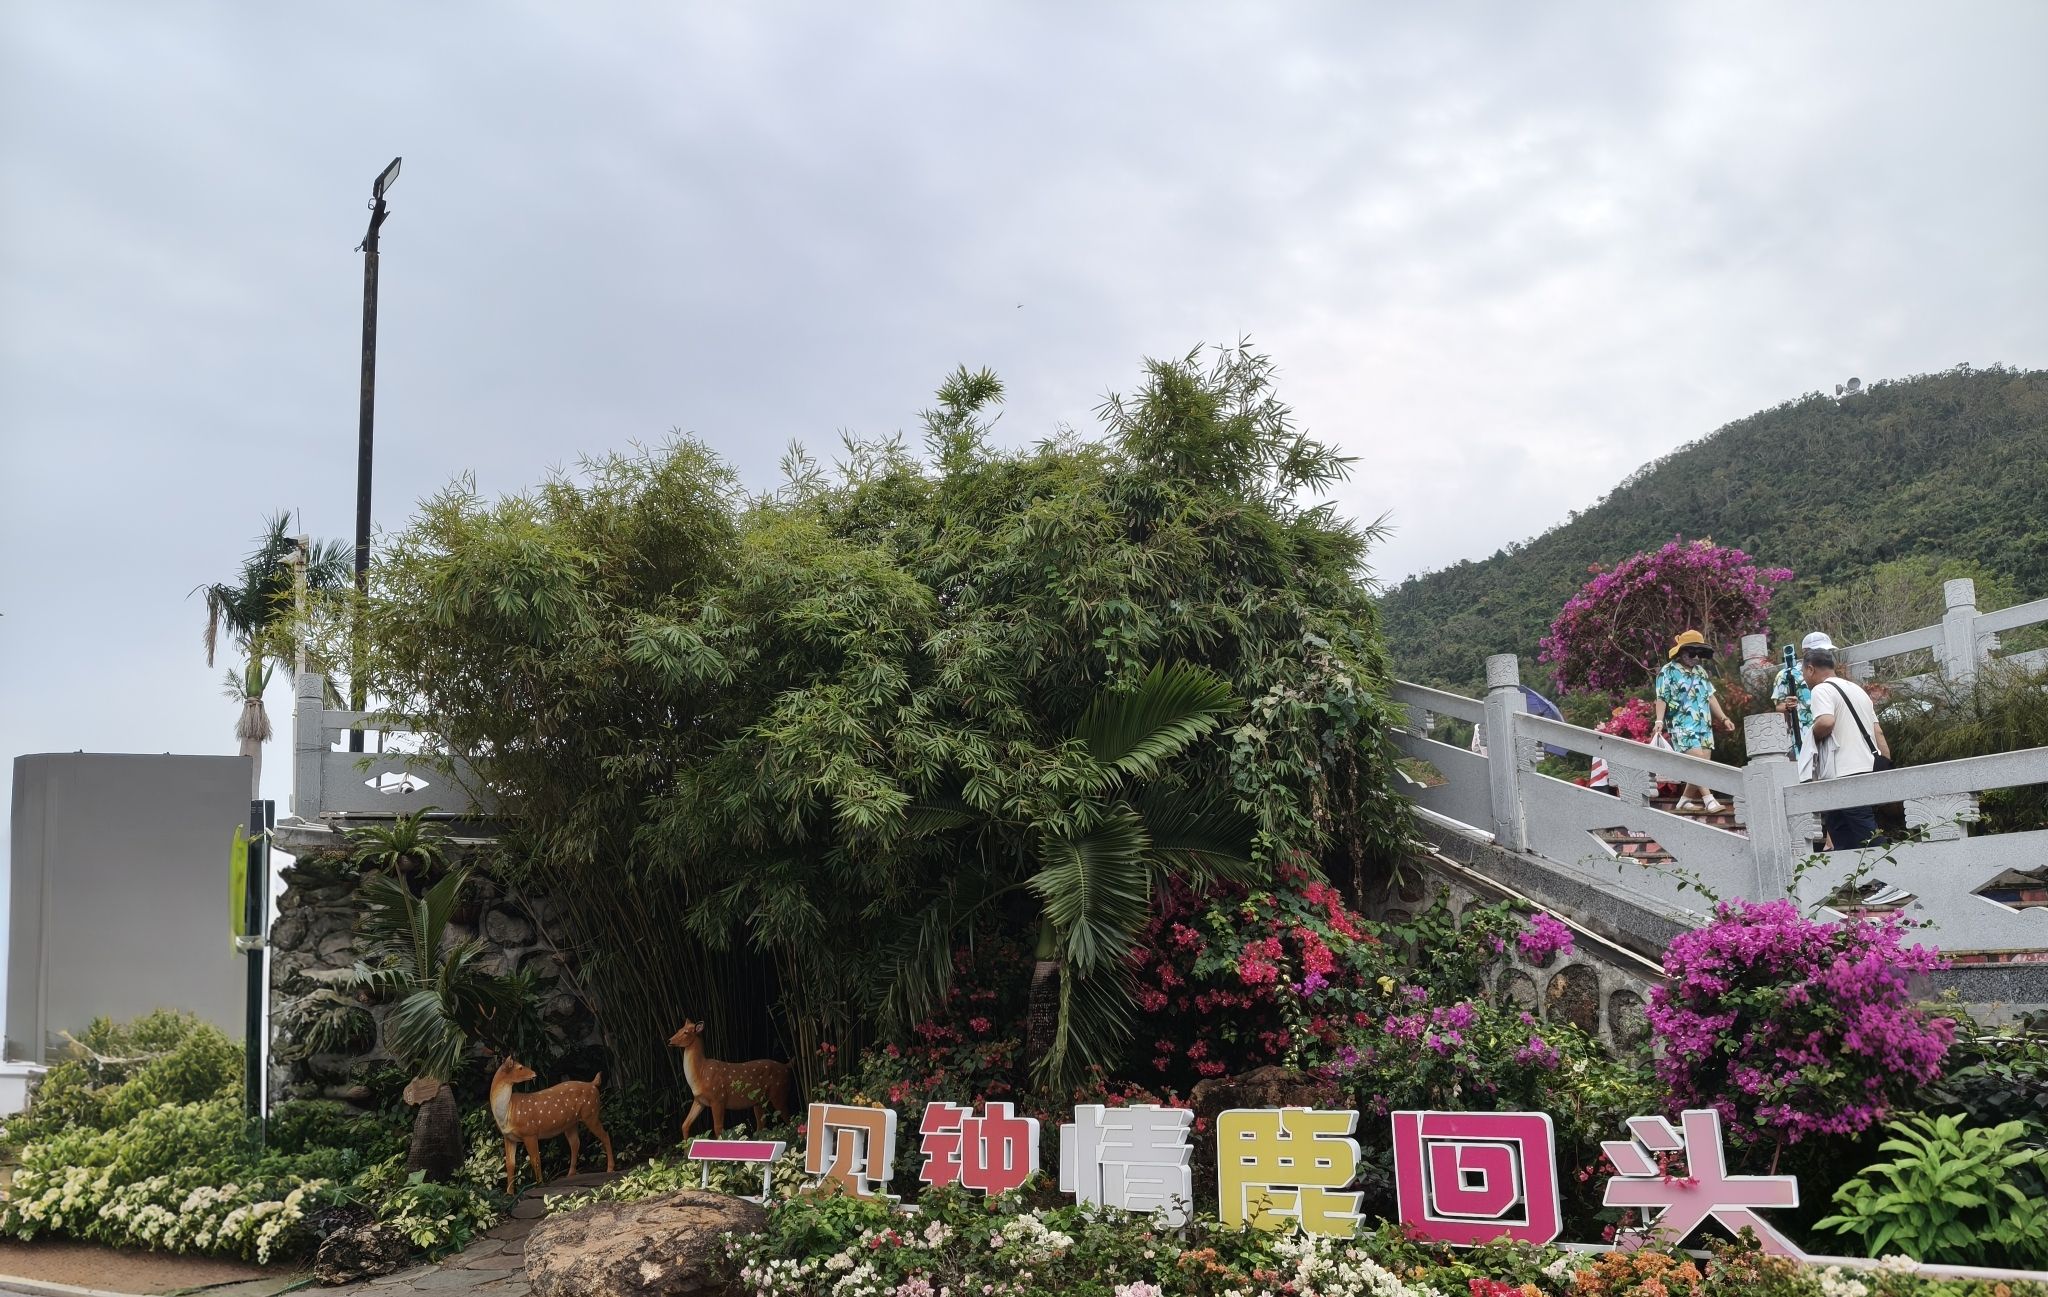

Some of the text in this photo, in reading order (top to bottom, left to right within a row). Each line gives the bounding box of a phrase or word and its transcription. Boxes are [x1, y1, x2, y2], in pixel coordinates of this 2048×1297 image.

[688, 1101, 1805, 1260] 一见钟情鹿回头
